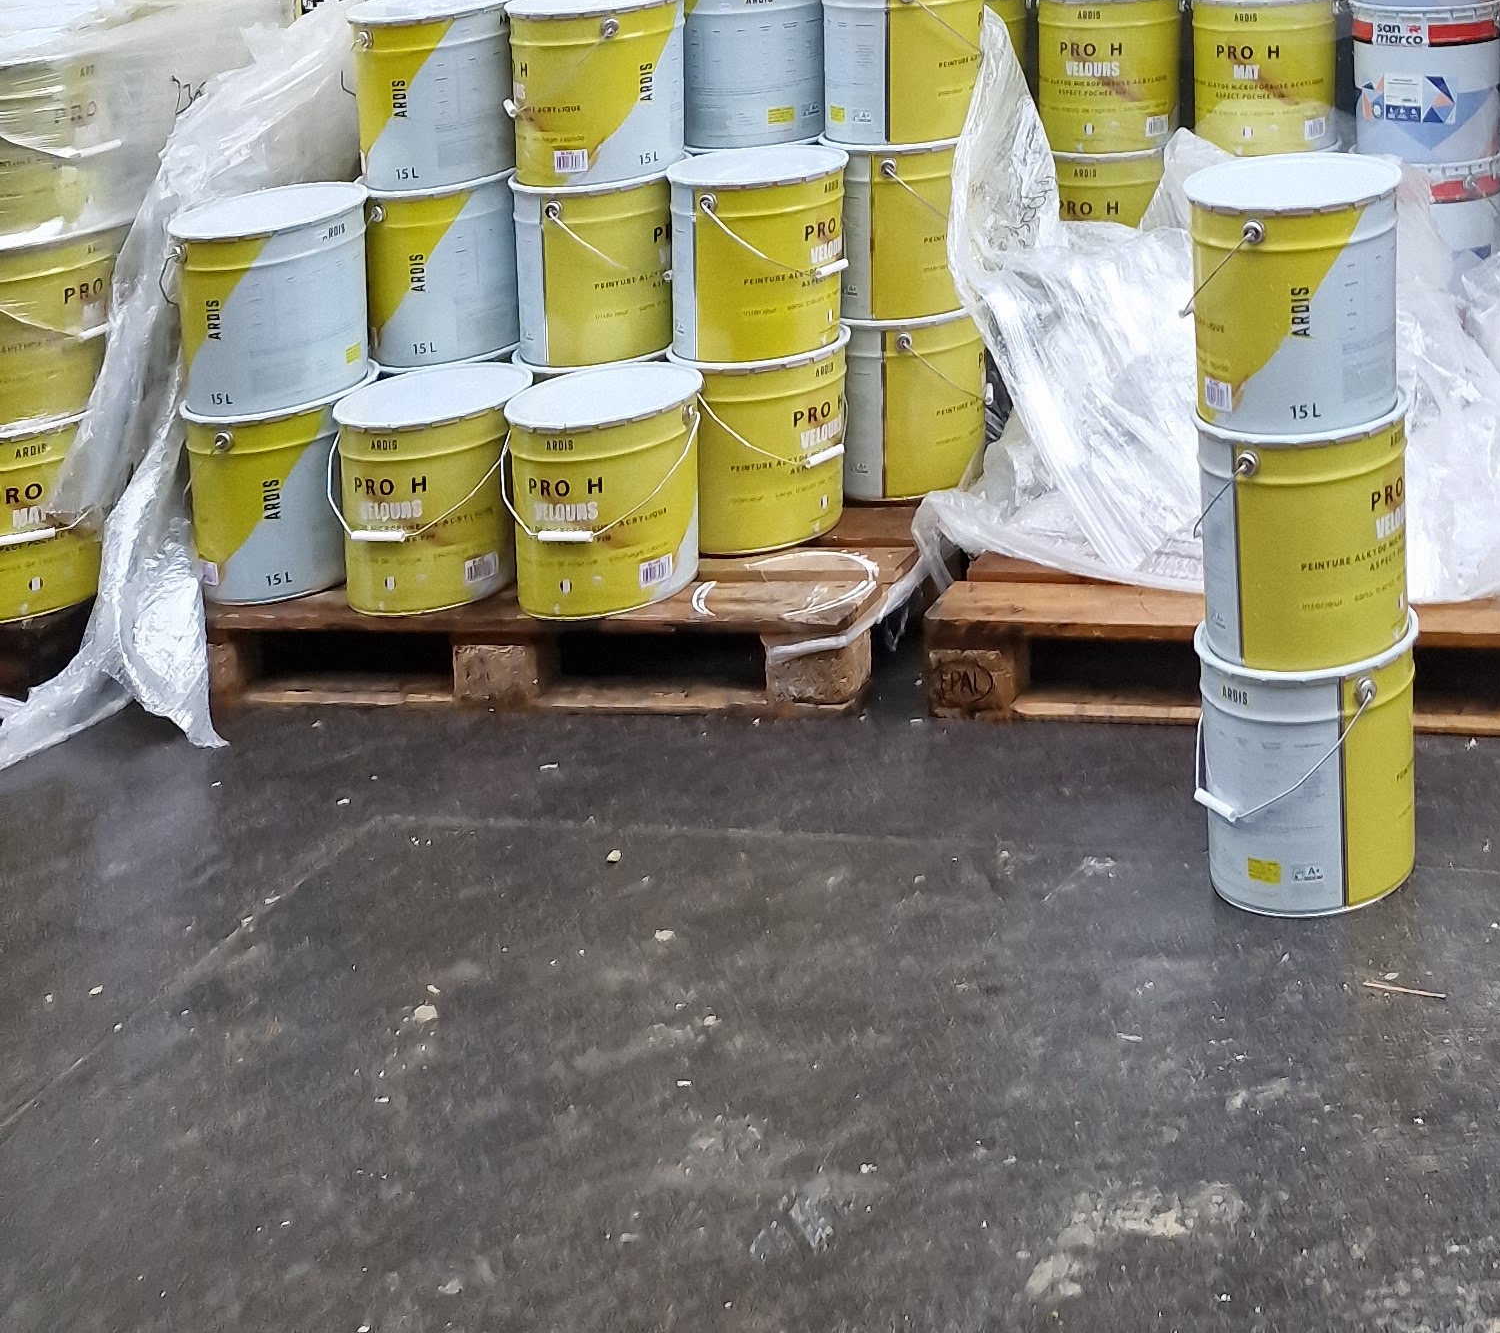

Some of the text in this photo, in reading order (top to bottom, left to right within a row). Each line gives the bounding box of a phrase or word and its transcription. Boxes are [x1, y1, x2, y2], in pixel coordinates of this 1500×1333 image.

[1377, 23, 1400, 33] san
[1376, 34, 1422, 45] marco
[1217, 45, 1280, 59] PRO H
[639, 62, 653, 101] ARDIS
[1234, 65, 1260, 79] MAT
[392, 79, 407, 117] ARDIS
[395, 167, 419, 180] 15 L
[805, 218, 836, 241] PRO
[409, 253, 425, 292] ARDIS
[205, 300, 221, 340] ARDIS
[1291, 287, 1310, 338] ARDIS
[413, 342, 437, 354] 15 L
[1290, 403, 1321, 420] 15 L
[546, 440, 573, 451] ARDIS
[529, 477, 603, 497] PRO H
[1371, 476, 1403, 512] PRO
[535, 502, 598, 521] VELOURS
[1301, 544, 1387, 572] PEINTURE ALKYDE
[1222, 685, 1247, 705] ARDIS
